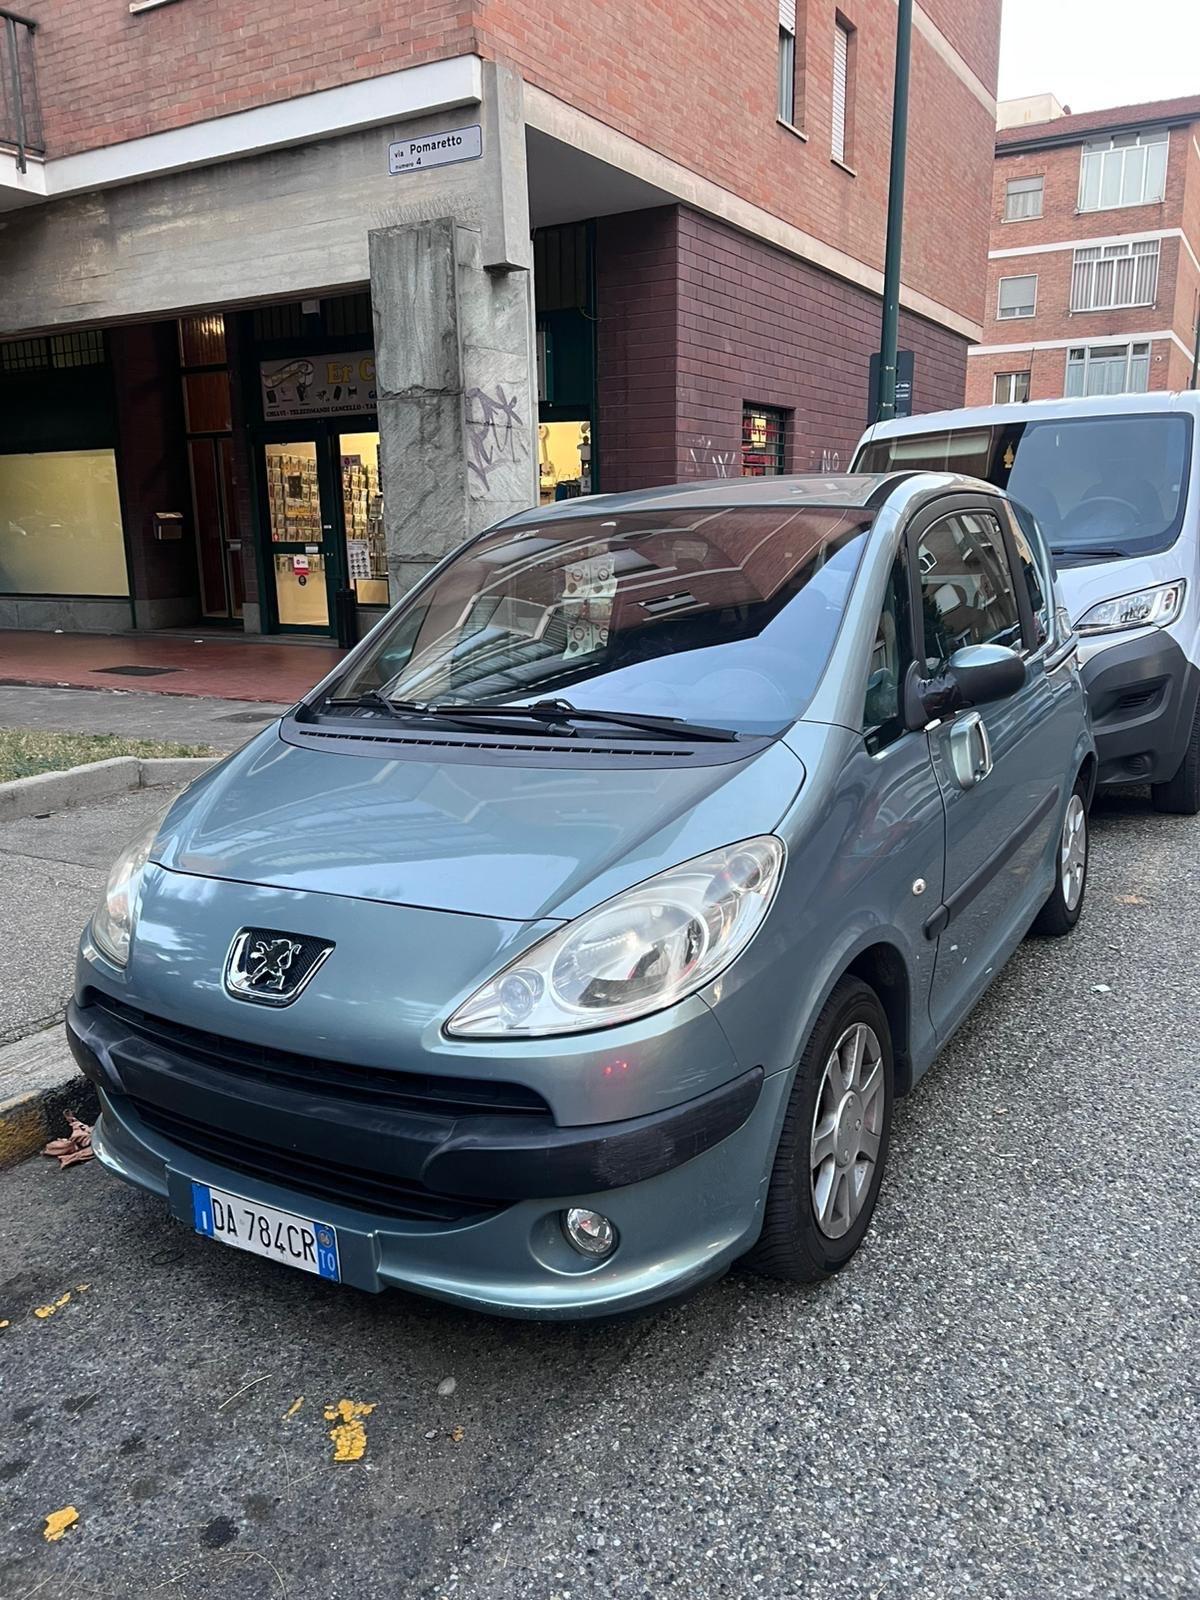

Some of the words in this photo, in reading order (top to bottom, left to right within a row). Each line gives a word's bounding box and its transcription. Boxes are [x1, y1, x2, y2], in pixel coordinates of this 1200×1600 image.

[394, 150, 404, 158] via
[410, 136, 462, 155] Pomaretto
[416, 157, 422, 165] 4
[327, 361, 353, 384] Er
[289, 406, 330, 415] TELECOMANDI
[331, 403, 361, 412] CANCELLO
[201, 1210, 208, 1230] I
[212, 1198, 239, 1237] DA
[243, 1209, 317, 1265] 784CR
[319, 1248, 336, 1272] TO
